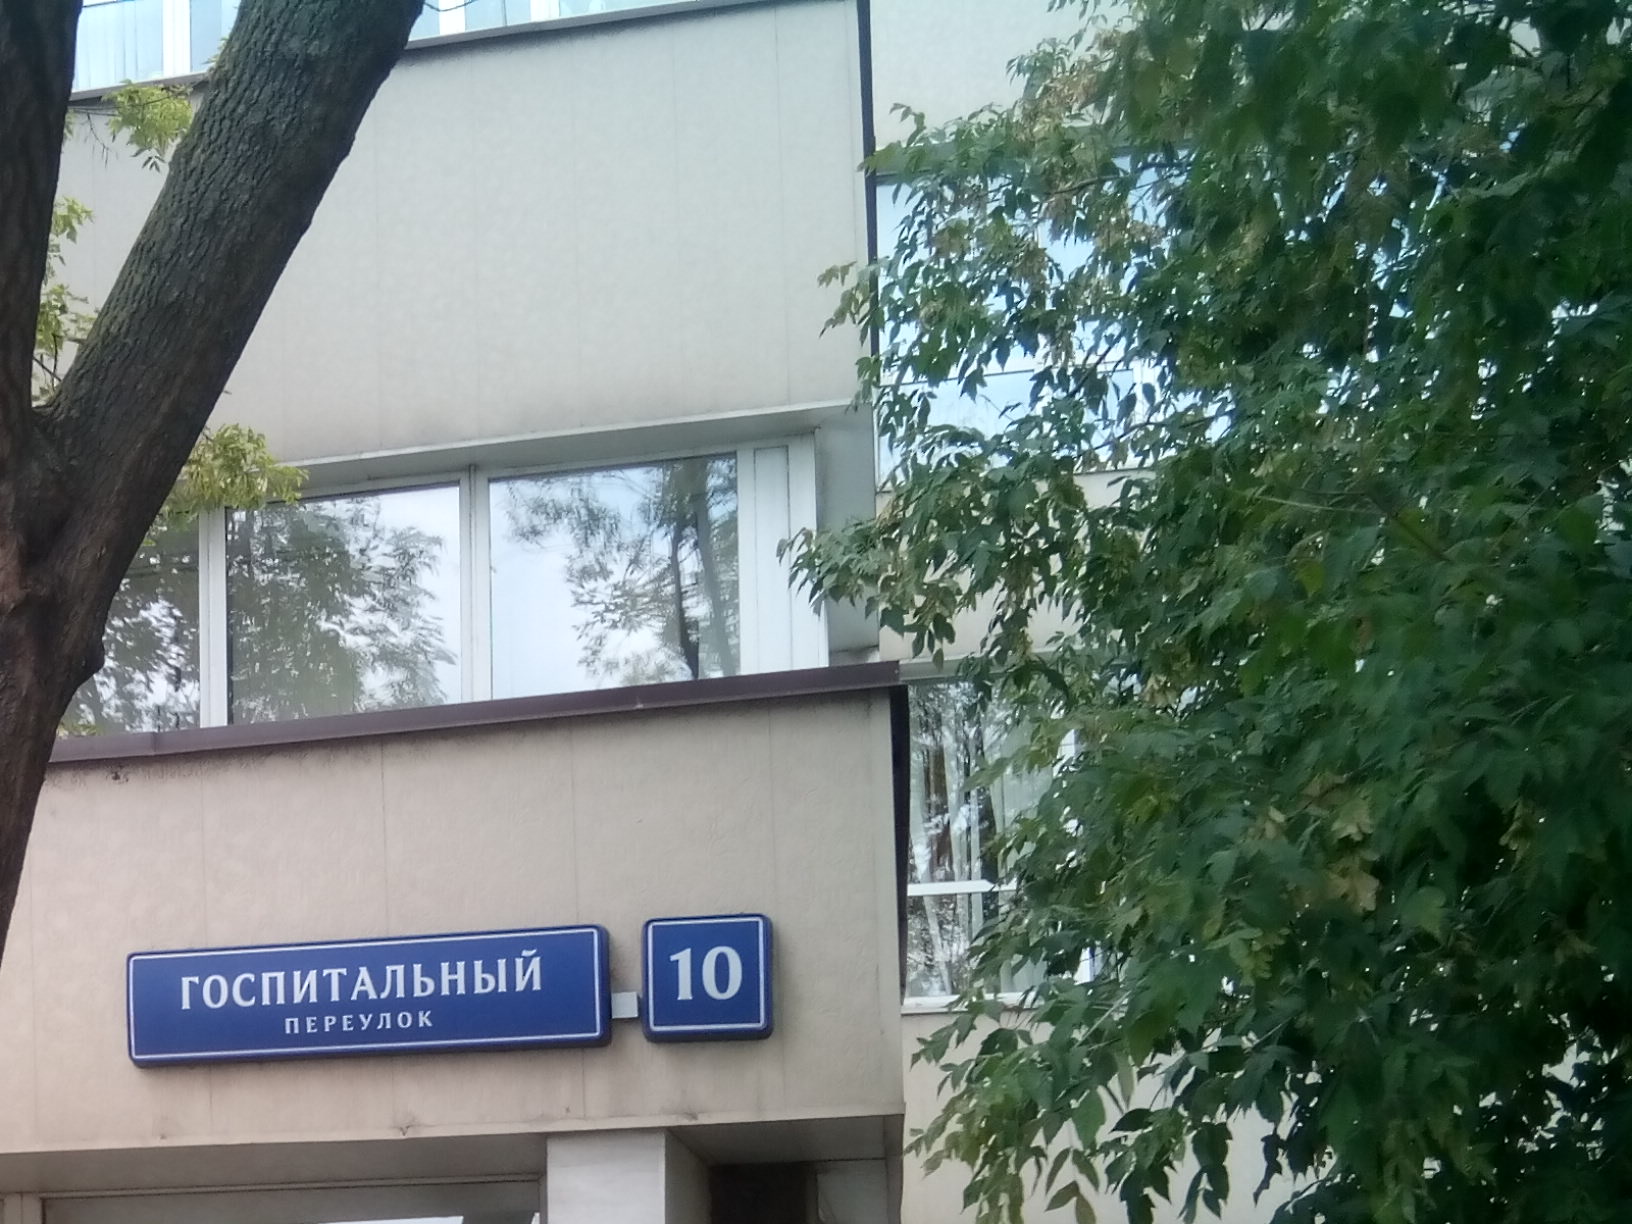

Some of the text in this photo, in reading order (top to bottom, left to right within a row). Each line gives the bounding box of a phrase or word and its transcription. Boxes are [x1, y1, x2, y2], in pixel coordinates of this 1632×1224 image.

[180, 948, 543, 1011] ГОСПИТАЛЬНЫЙ
[669, 945, 743, 1001] 10
[284, 1010, 434, 1034] ПЕРЕУЛОК
